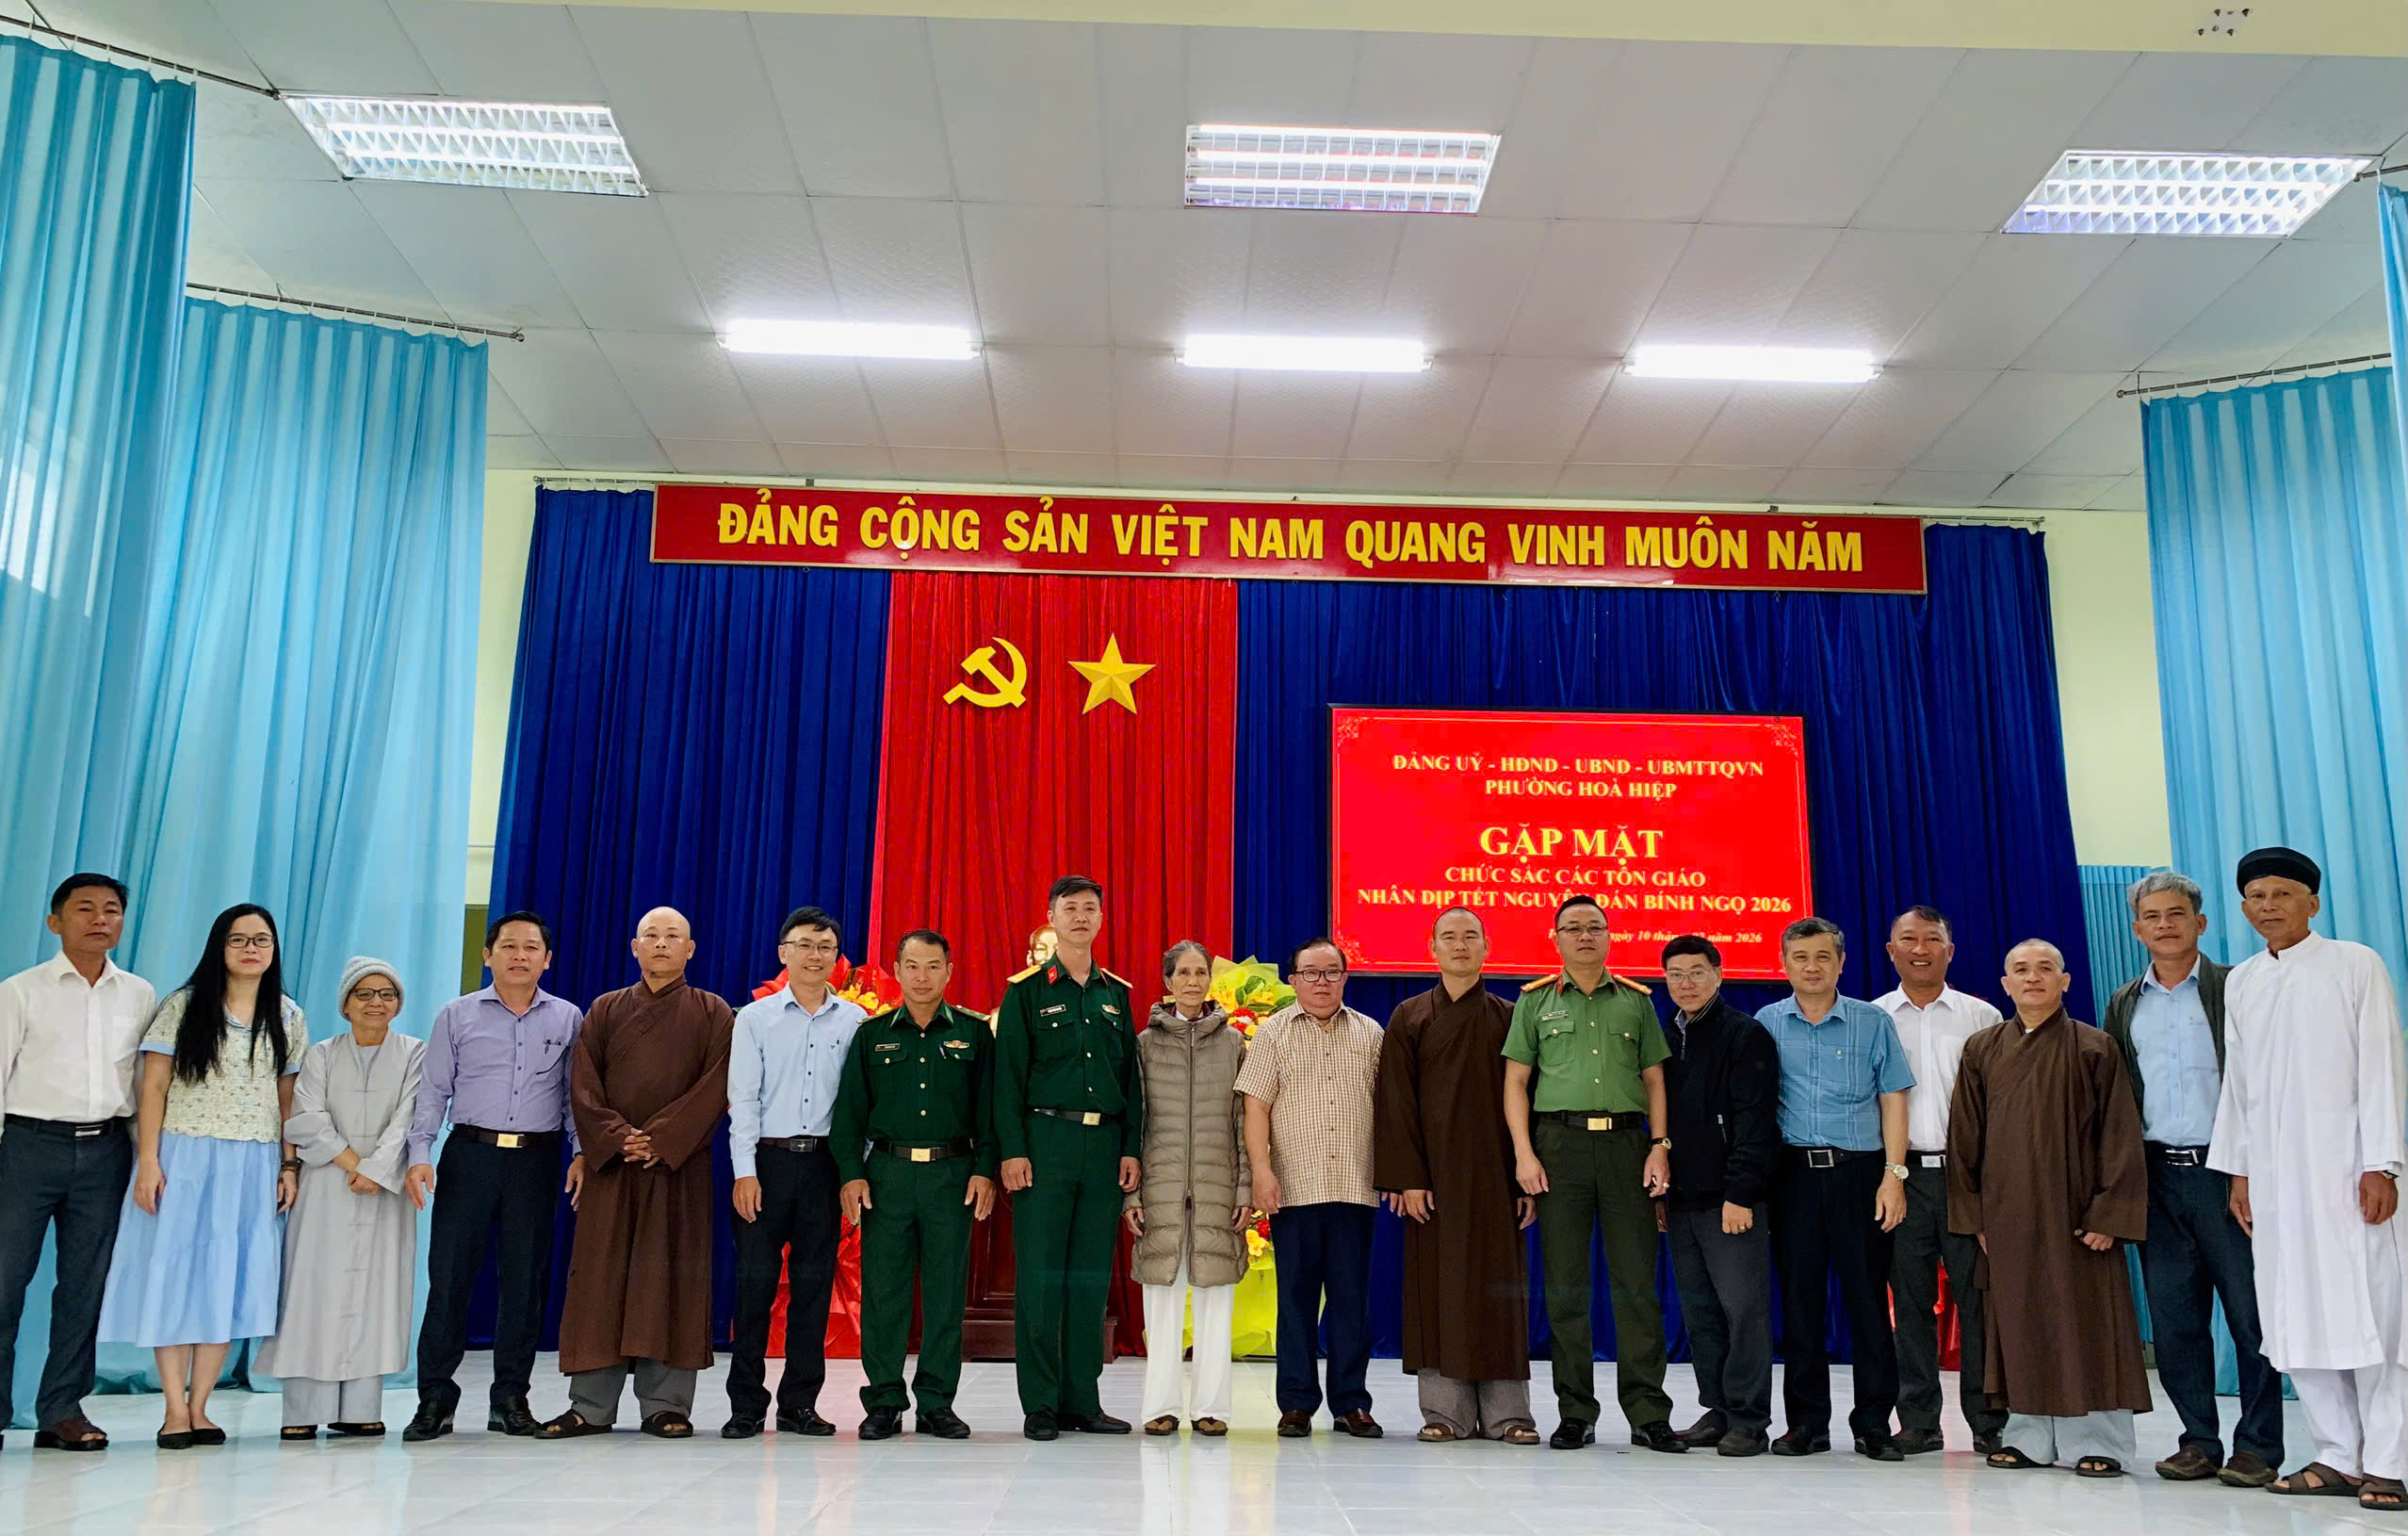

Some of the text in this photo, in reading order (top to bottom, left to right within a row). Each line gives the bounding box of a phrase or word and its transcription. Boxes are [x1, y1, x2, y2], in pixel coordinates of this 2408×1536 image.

[717, 487, 1863, 572] ĐẢNG CỘNG SẢN VIỆT NAM QUANG VINH MUÔN NĂM
[1393, 751, 1451, 771] ĐẢNG
[1501, 757, 1558, 773] HĐND
[1575, 759, 1632, 775] UBND
[1648, 760, 1764, 779] UBMTTQVN
[1485, 776, 1573, 797] PHƯỜNG
[1629, 781, 1678, 802] HIỆP
[1479, 823, 1664, 866] GẶP MẶT
[1444, 862, 1505, 883] CHỨC
[1554, 865, 1599, 885] CÁC
[1651, 868, 1707, 888] GIÁO
[1357, 884, 1416, 906] NHÂN
[1422, 890, 1456, 909] DỊP
[1503, 889, 1590, 907] NGUYÊ
[1644, 891, 1694, 911] BÍNH
[1700, 896, 1747, 915] NGỌ
[1750, 896, 1793, 912] 2026
[1638, 930, 1651, 941] 10
[1735, 932, 1763, 943] 2026
